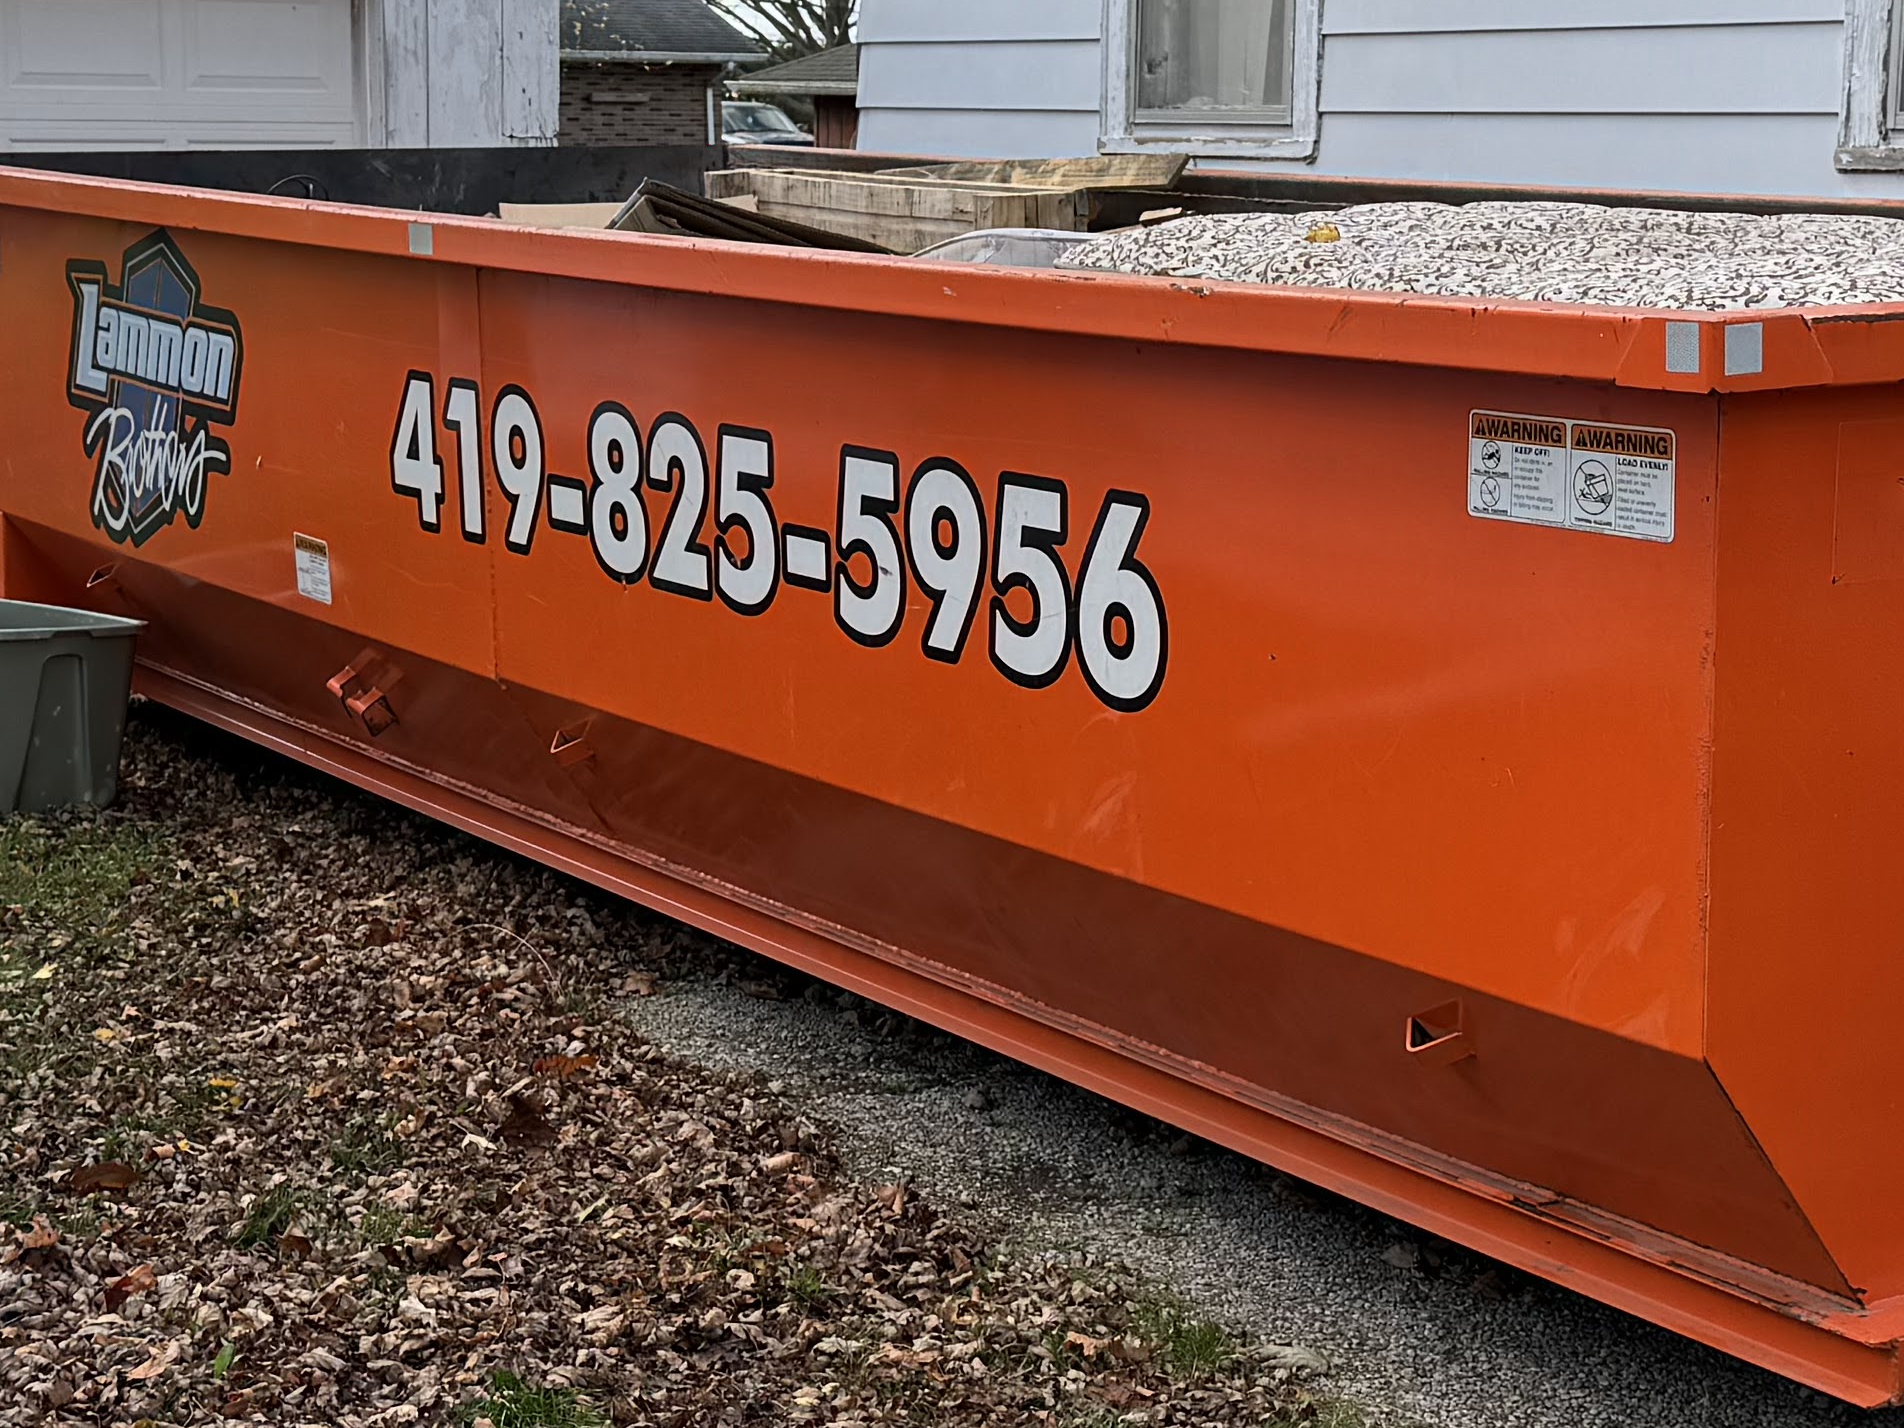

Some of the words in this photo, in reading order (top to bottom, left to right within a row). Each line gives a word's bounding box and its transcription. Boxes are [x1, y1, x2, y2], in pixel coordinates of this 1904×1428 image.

[74, 281, 236, 400] Lammon
[86, 394, 227, 531] Brothers
[1486, 418, 1562, 444] WARNING
[1587, 429, 1668, 455] WARNING
[390, 371, 1168, 712] 419-825-5956
